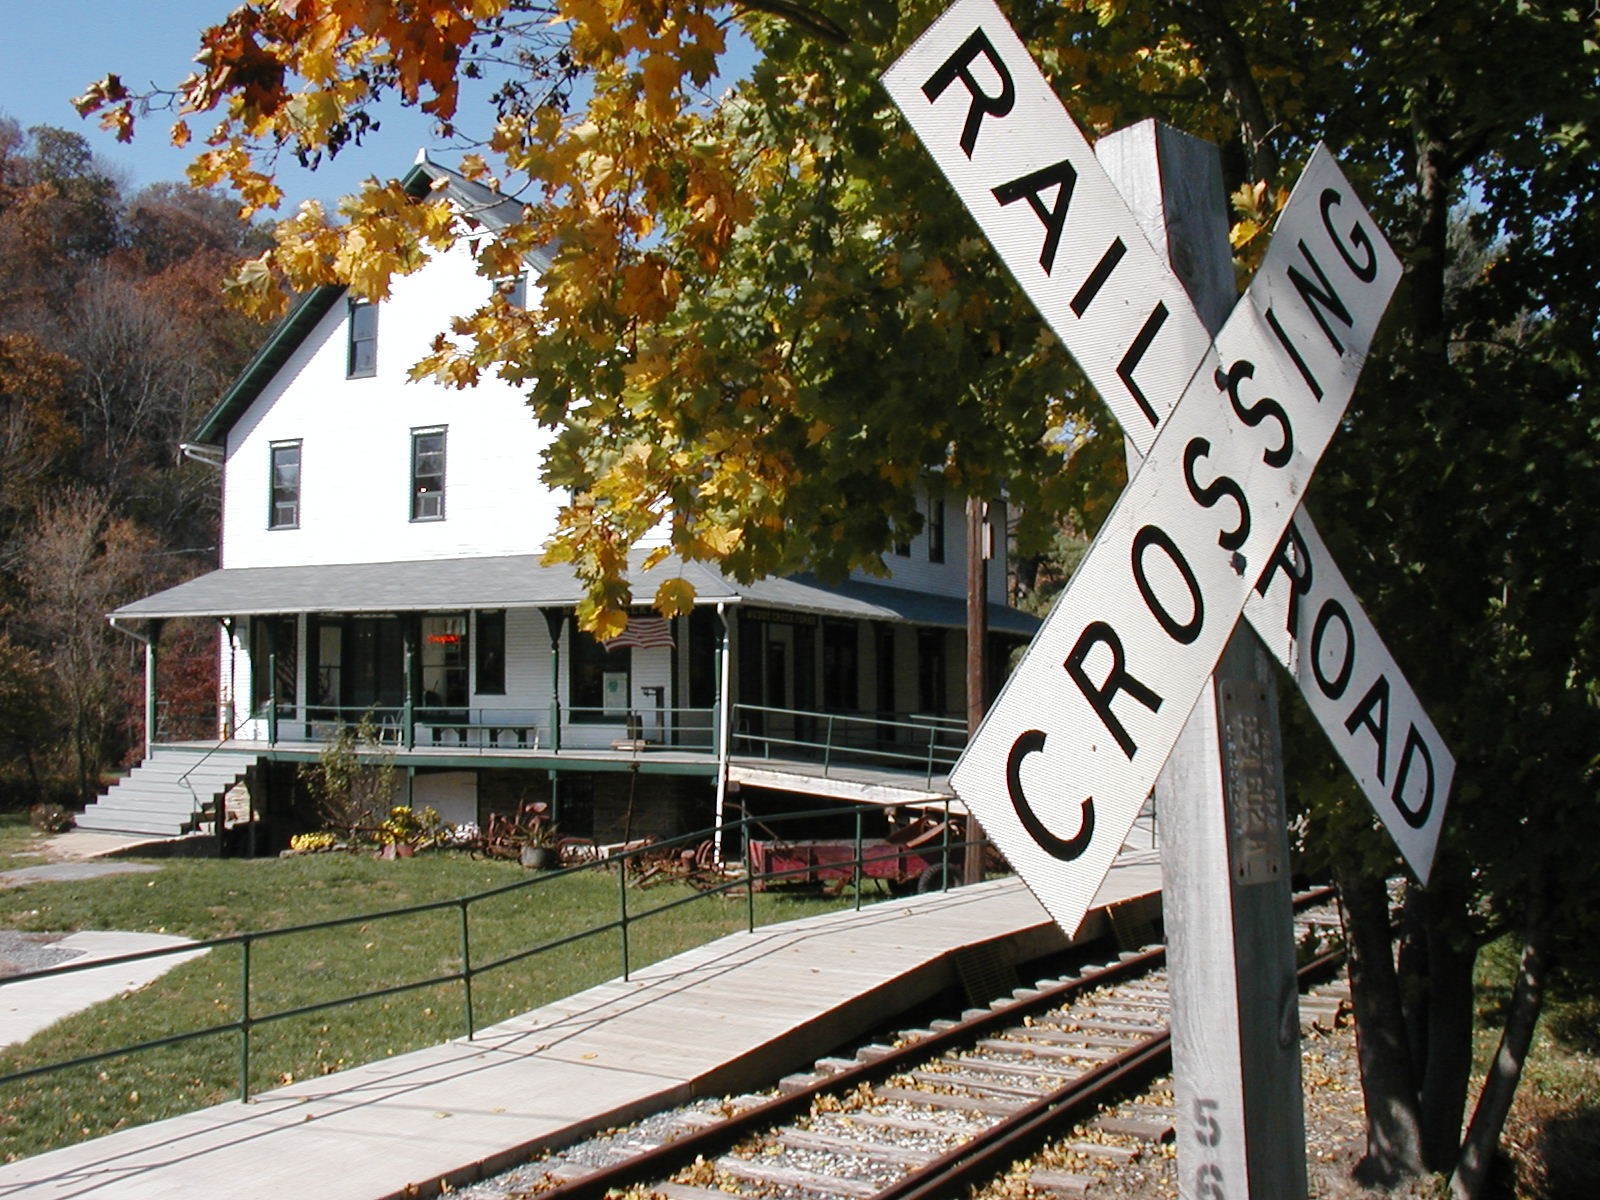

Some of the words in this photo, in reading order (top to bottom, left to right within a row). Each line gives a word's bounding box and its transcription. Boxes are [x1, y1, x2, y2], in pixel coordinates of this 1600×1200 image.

[921, 26, 1169, 429] RAIL
[1006, 188, 1378, 861] CROSSING
[1254, 517, 1435, 829] ROAD
